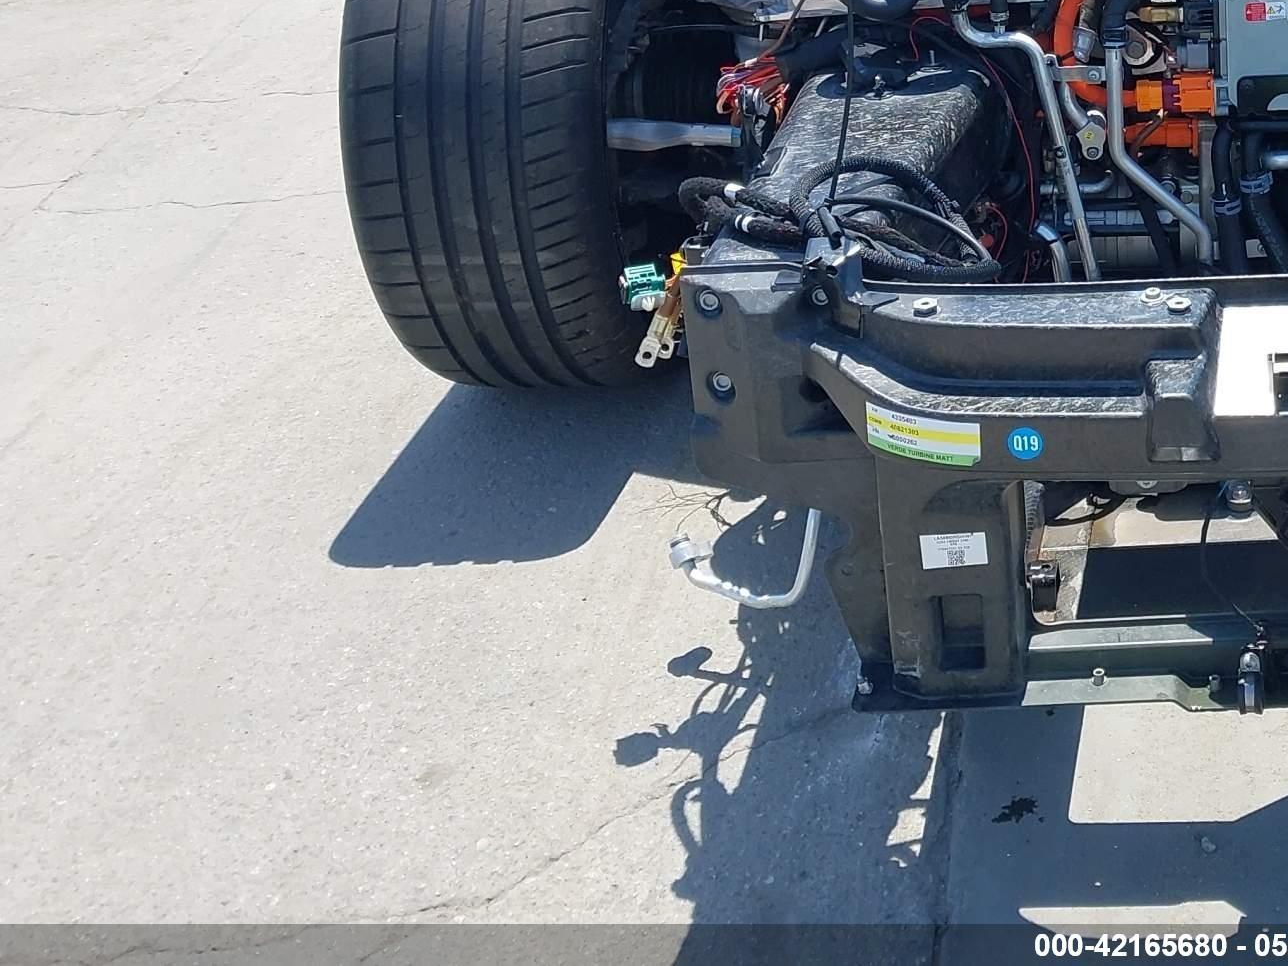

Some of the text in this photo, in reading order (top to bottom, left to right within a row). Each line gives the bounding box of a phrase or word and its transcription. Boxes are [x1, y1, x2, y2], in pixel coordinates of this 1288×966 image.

[1013, 435, 1039, 451] Q19
[887, 443, 953, 462] VERDE TURBINE MATT
